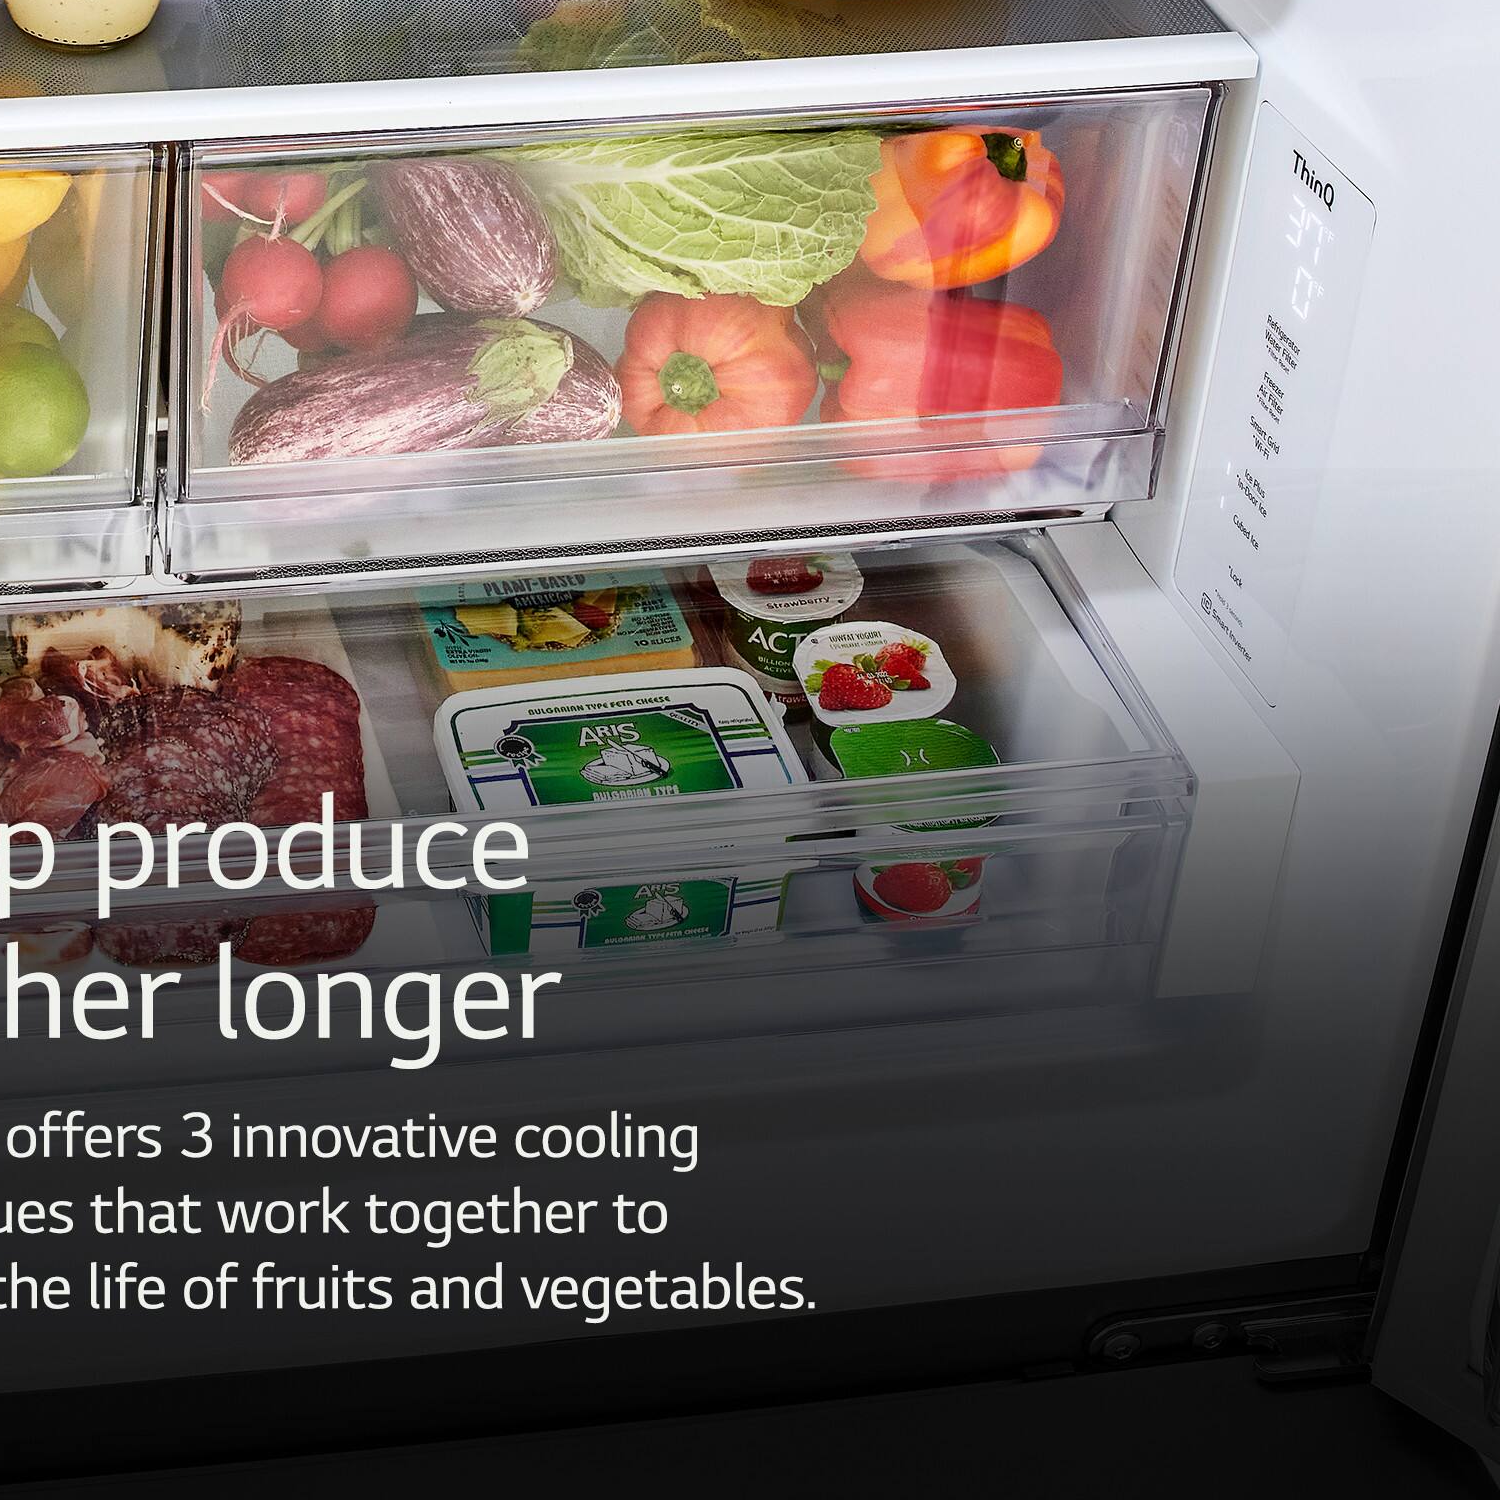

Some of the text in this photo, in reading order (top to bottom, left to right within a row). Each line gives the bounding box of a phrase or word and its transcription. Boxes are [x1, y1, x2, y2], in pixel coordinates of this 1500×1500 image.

[1292, 149, 1335, 212] ThinQ
[1267, 314, 1301, 356] Refrigerator
[1265, 328, 1297, 370] Water Filter
[1263, 371, 1285, 399] Freezer
[1268, 394, 1284, 415] Filter
[1250, 415, 1280, 454] Smart Grid
[1253, 479, 1266, 499] Plus
[1233, 514, 1251, 539] Cubed
[765, 594, 831, 610] Strawberry
[634, 634, 682, 648] 10 SLICES
[1212, 608, 1230, 636] Smart
[1228, 629, 1252, 662] Inverter
[527, 694, 671, 716] BULGARIAN TYPE FETA CHEESE
[669, 711, 701, 728] QUALITY
[577, 721, 642, 748] ARIS
